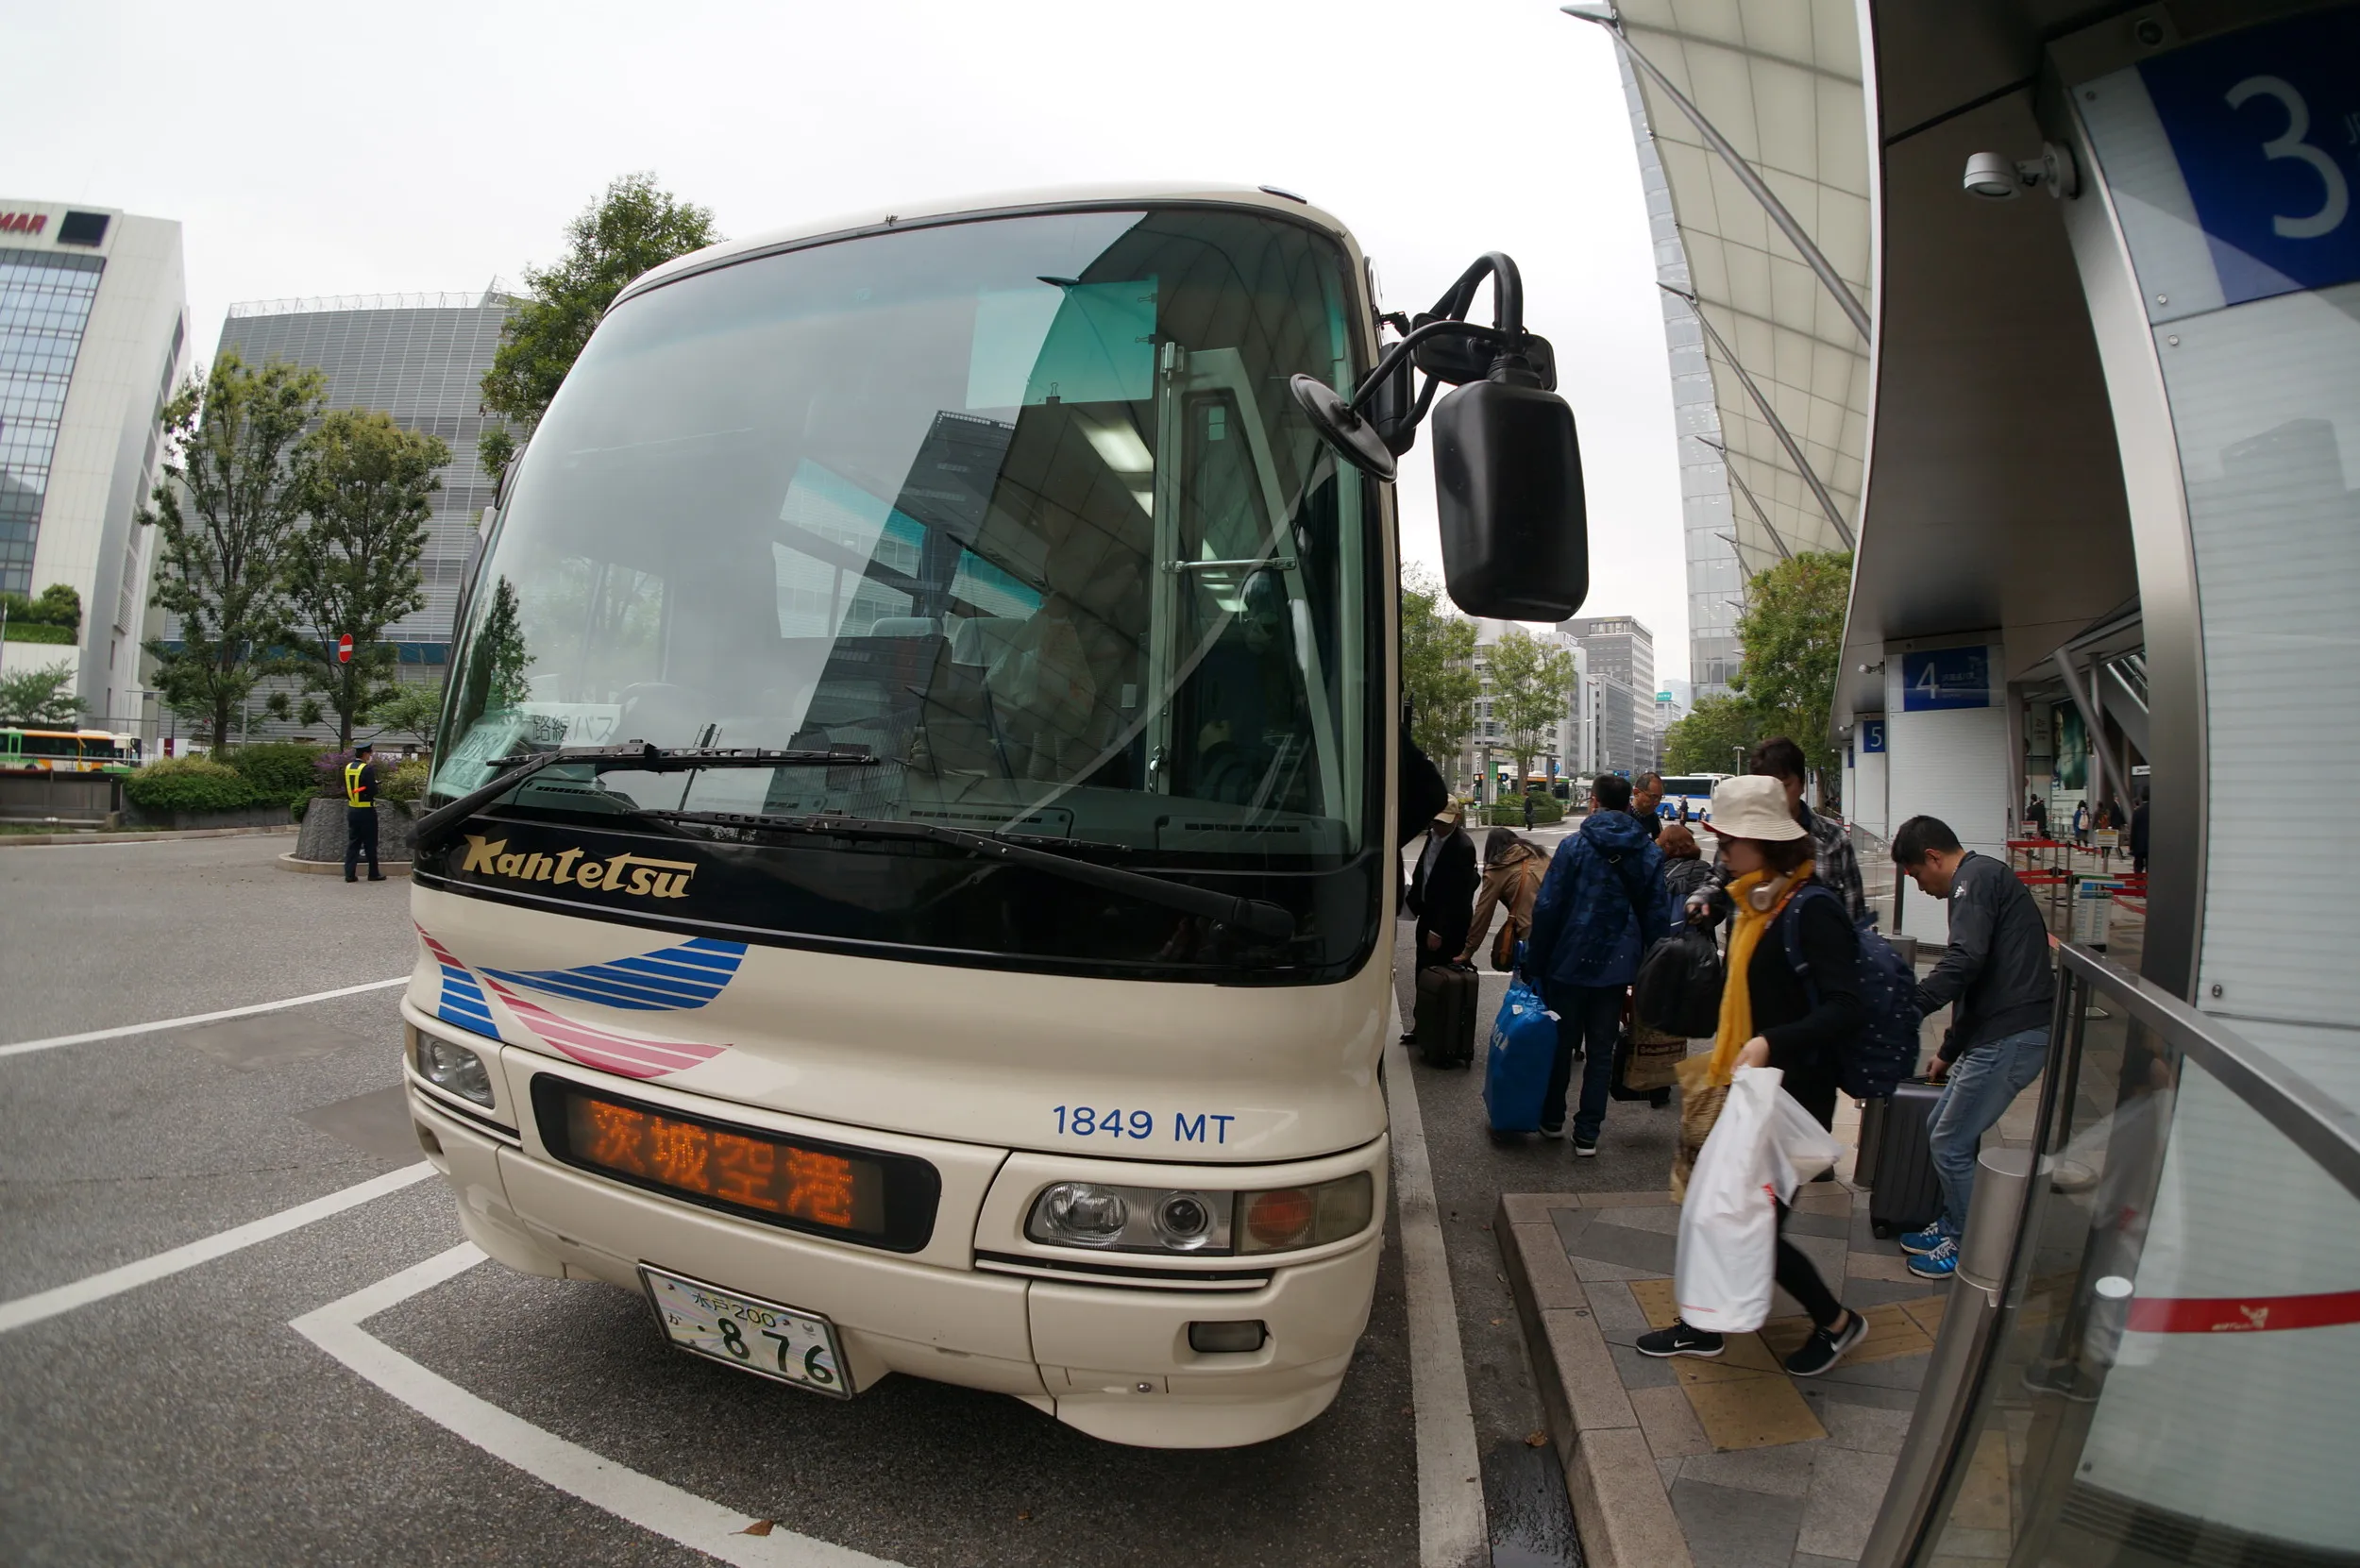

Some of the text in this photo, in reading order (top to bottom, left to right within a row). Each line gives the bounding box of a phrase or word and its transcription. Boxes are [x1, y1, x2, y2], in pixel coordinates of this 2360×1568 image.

[2224, 75, 2350, 239] 3
[1915, 662, 1940, 700] 4
[531, 713, 614, 743] 路線バス
[1870, 726, 1882, 748] 5
[462, 834, 698, 899] Kantetsu
[1053, 1104, 1236, 1145] 1849 MT
[589, 1099, 854, 1228] 茨城空港
